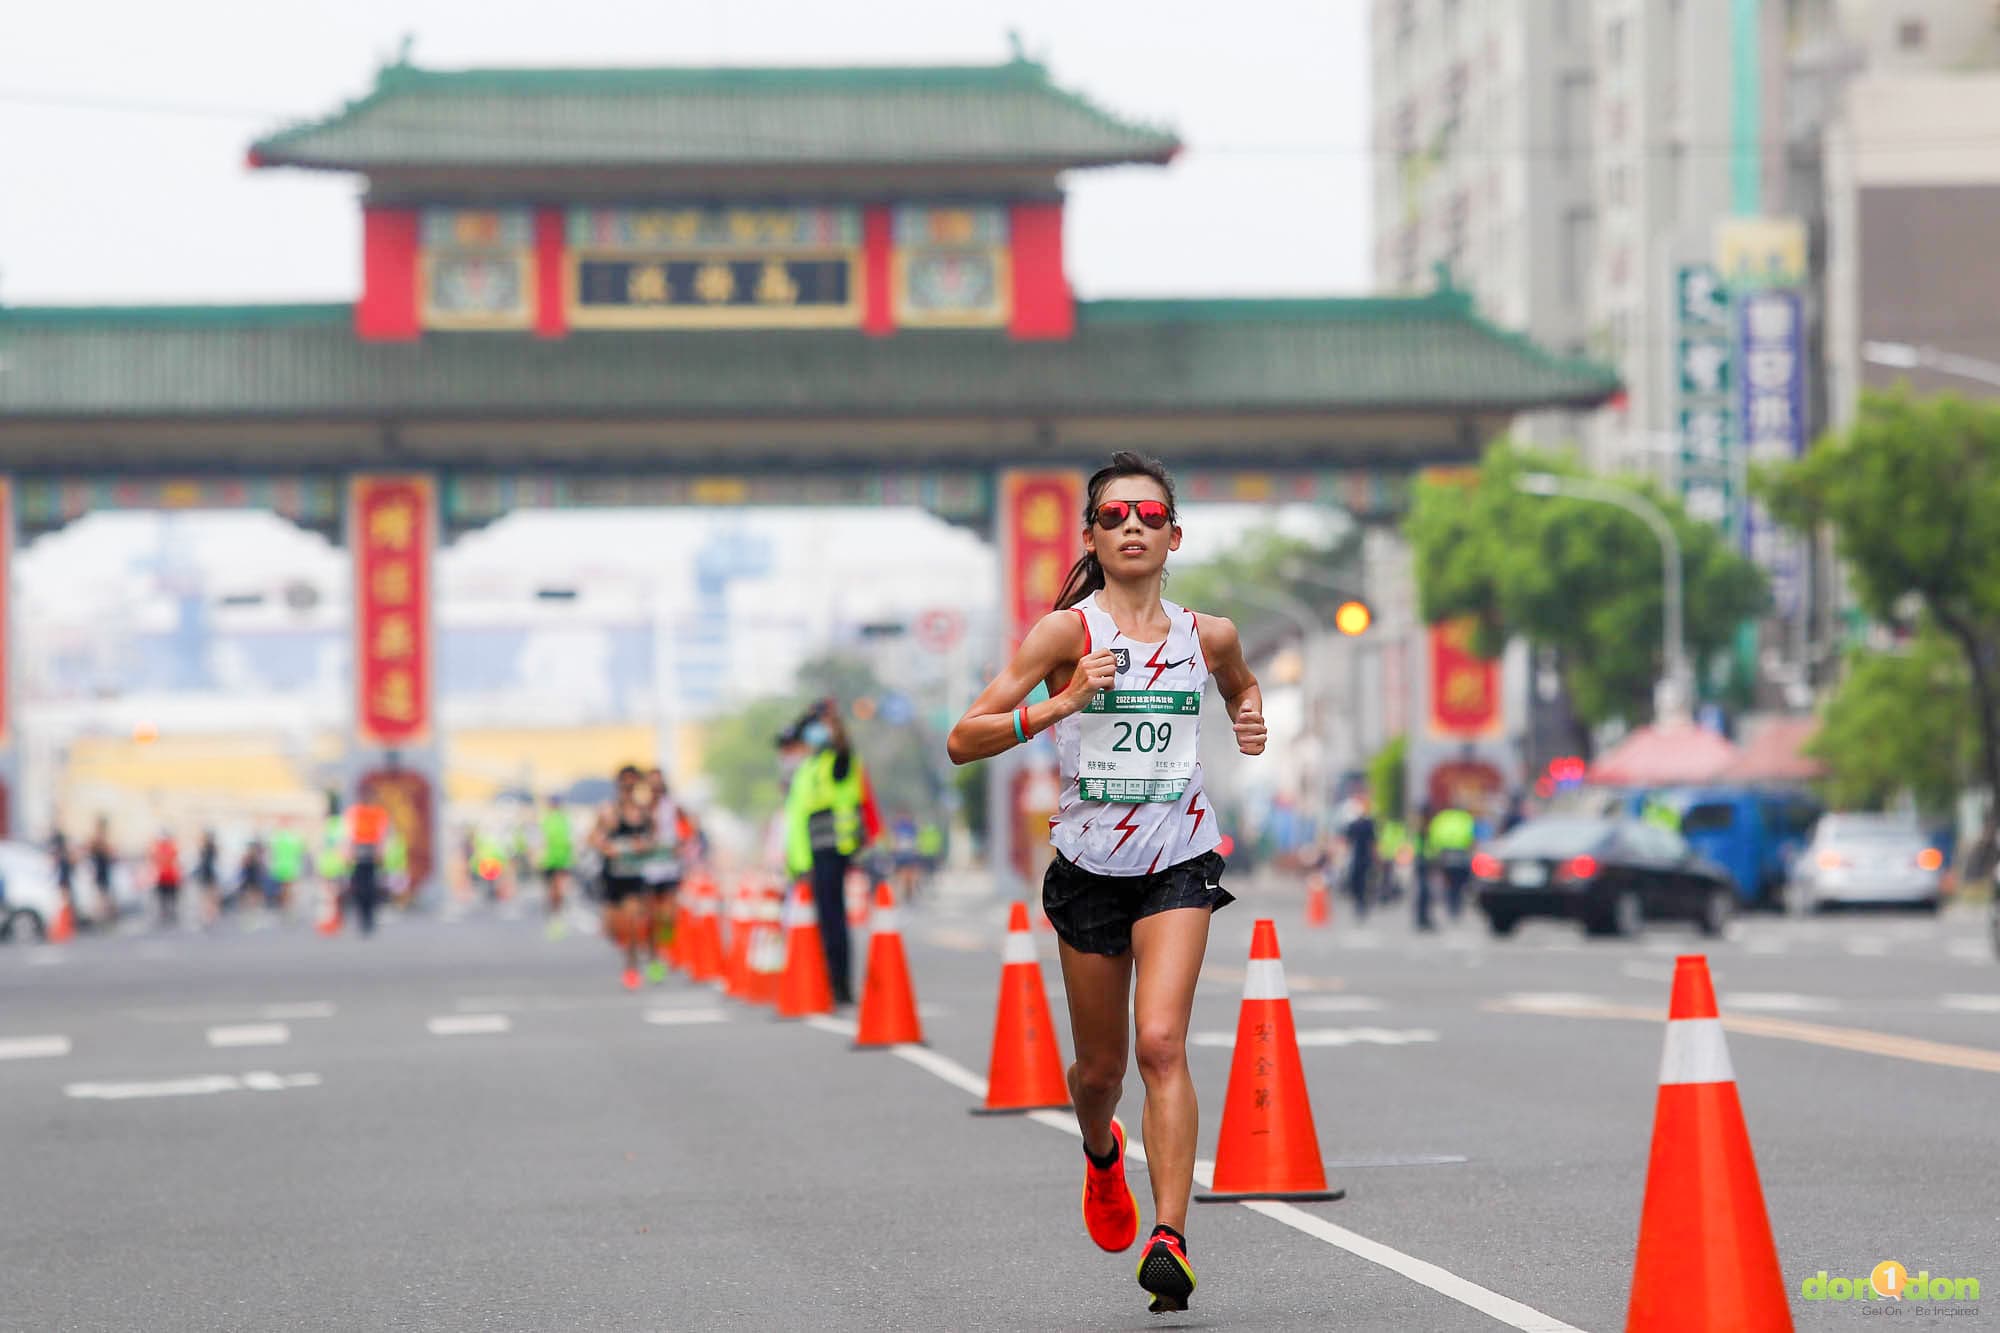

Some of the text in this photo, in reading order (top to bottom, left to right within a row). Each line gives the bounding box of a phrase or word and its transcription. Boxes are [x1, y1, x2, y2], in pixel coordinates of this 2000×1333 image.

[1112, 721, 1172, 753] 209
[1252, 1023, 1273, 1135] 安全第一
